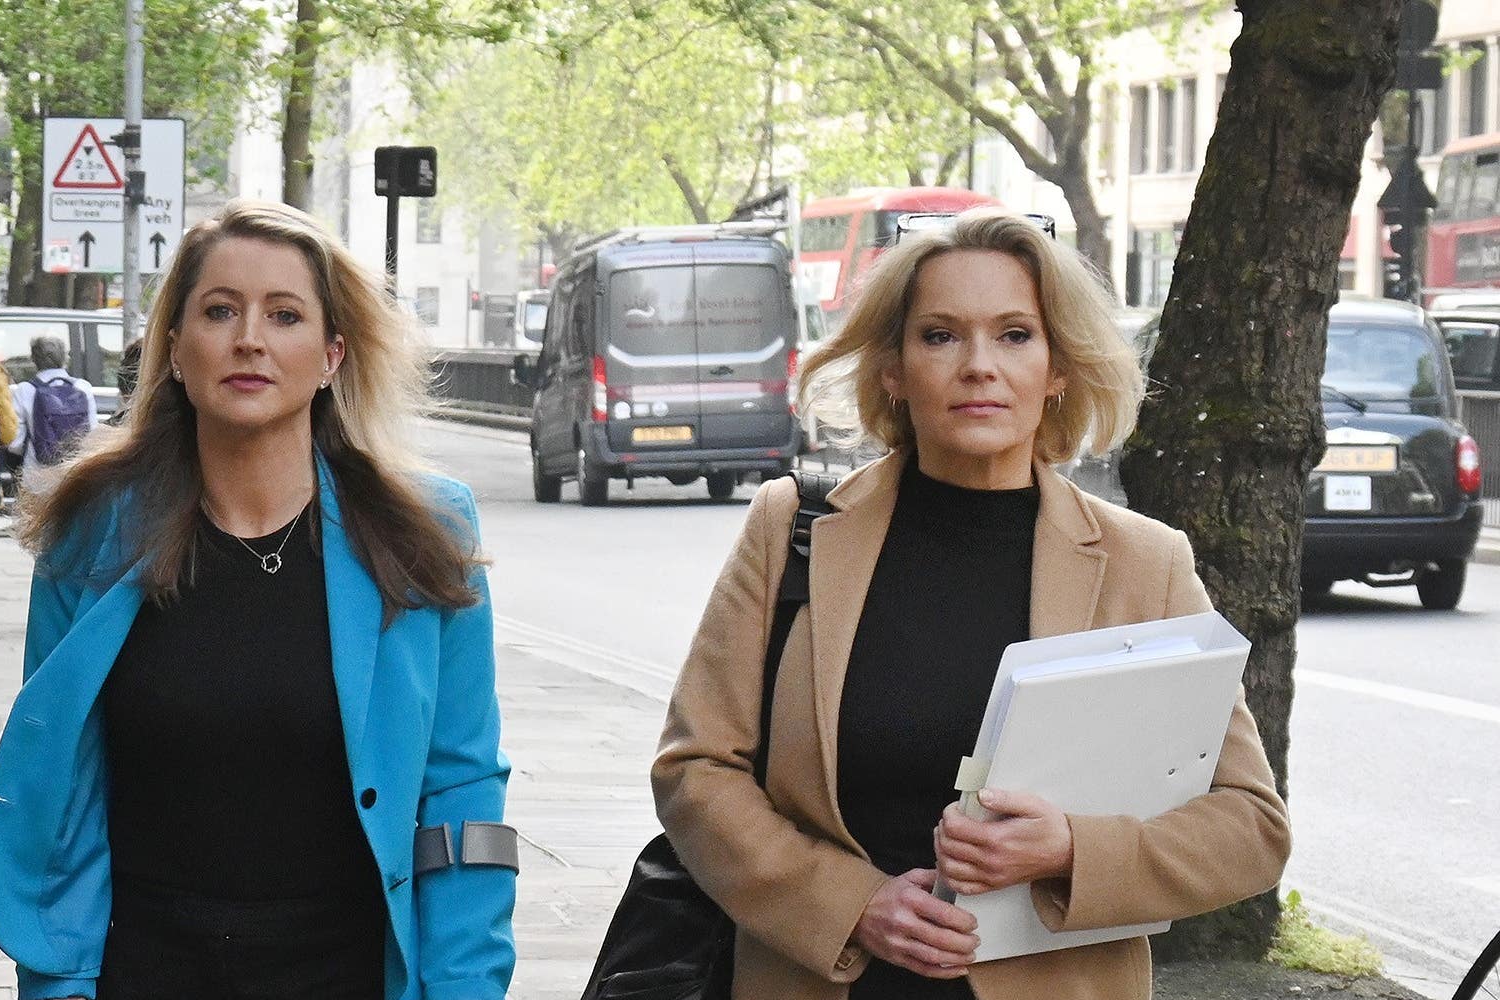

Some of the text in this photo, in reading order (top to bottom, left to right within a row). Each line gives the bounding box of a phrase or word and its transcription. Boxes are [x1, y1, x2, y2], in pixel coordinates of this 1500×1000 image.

[55, 197, 120, 209] Overhanging
[146, 196, 172, 209] Any
[145, 212, 171, 224] veh
